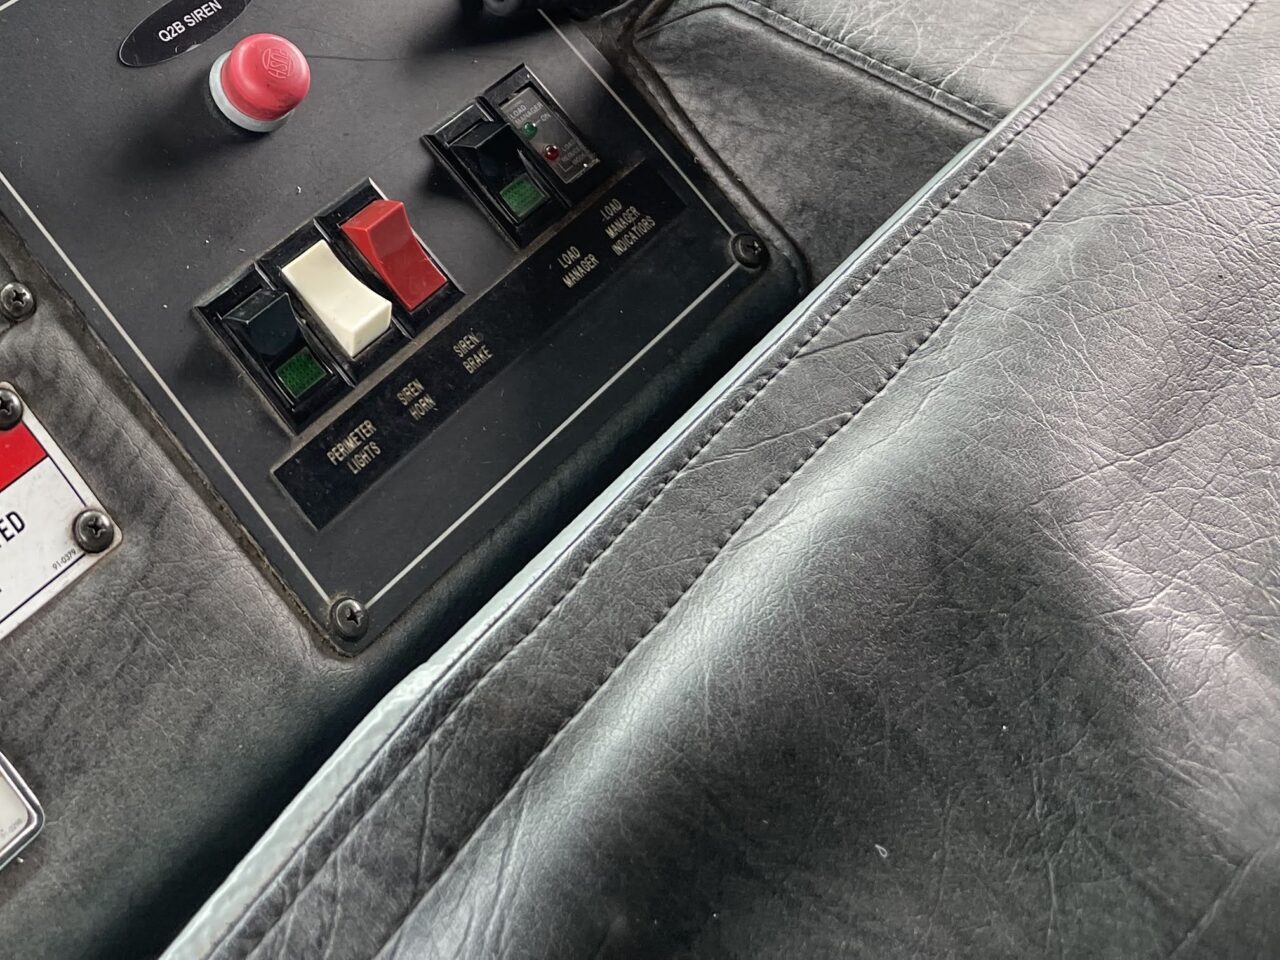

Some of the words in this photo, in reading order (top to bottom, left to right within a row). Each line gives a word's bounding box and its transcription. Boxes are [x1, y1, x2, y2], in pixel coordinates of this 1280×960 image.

[158, 20, 186, 43] Q2B
[183, 0, 223, 28] SIREN
[509, 103, 527, 120] LOAD
[515, 102, 544, 124] MANAGER
[601, 199, 623, 220] LOAD
[605, 206, 641, 239] MANAGER
[558, 246, 581, 269] LOAD
[562, 254, 599, 288] MANAGER
[452, 331, 479, 358] SIREN
[463, 345, 493, 375] BRAKE
[397, 378, 425, 406] SIREN
[410, 395, 437, 421] HORN
[326, 419, 377, 466] PERIMETER
[348, 442, 381, 475] LIGHTS
